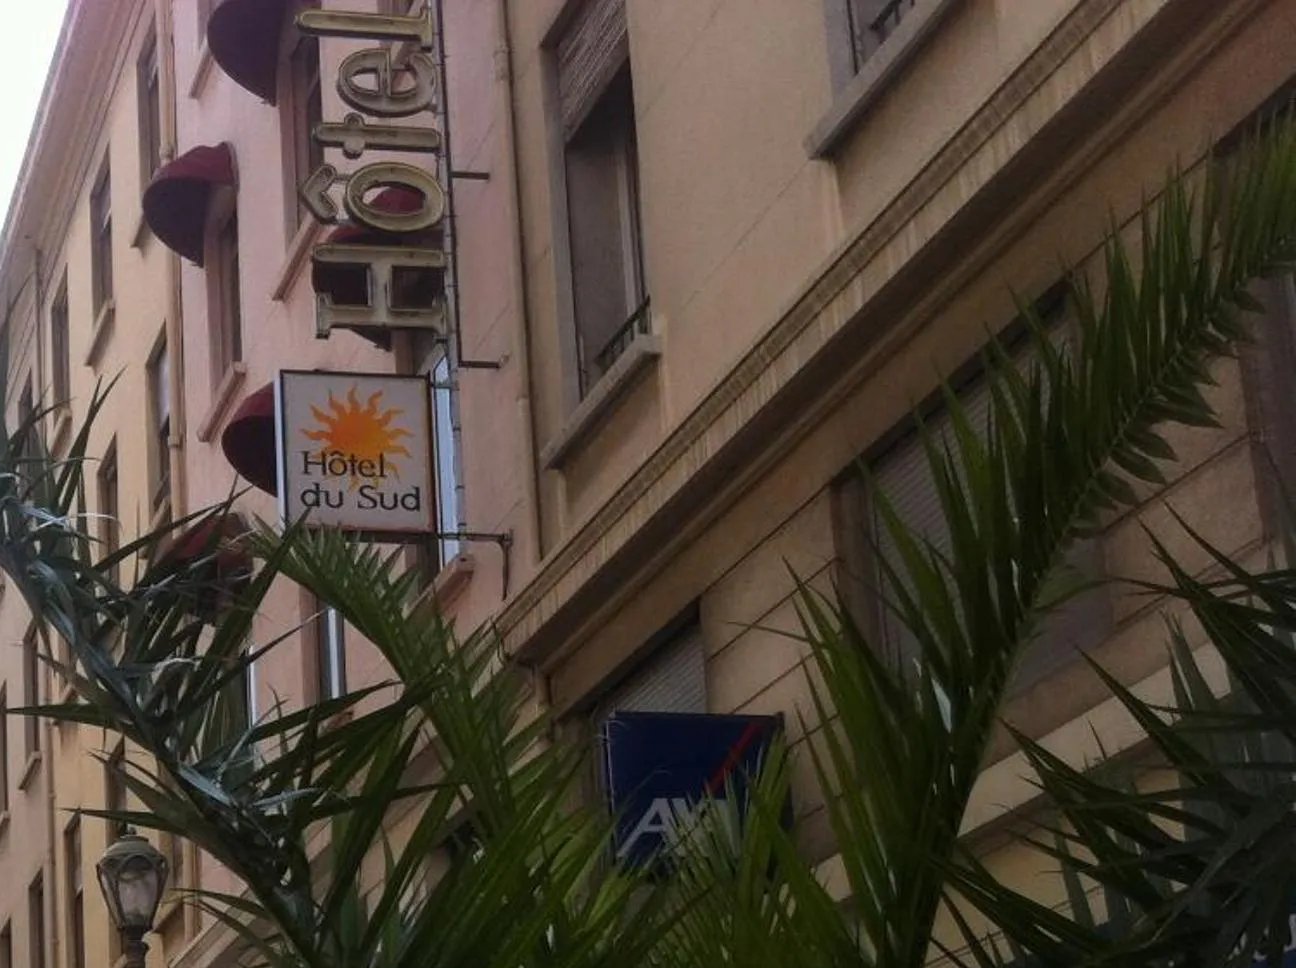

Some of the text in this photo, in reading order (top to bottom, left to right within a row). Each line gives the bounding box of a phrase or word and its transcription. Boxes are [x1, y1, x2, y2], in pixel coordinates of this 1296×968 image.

[300, 10, 446, 341] Hôtel
[300, 451, 388, 478] Hôtel
[300, 483, 421, 512] du Sud
